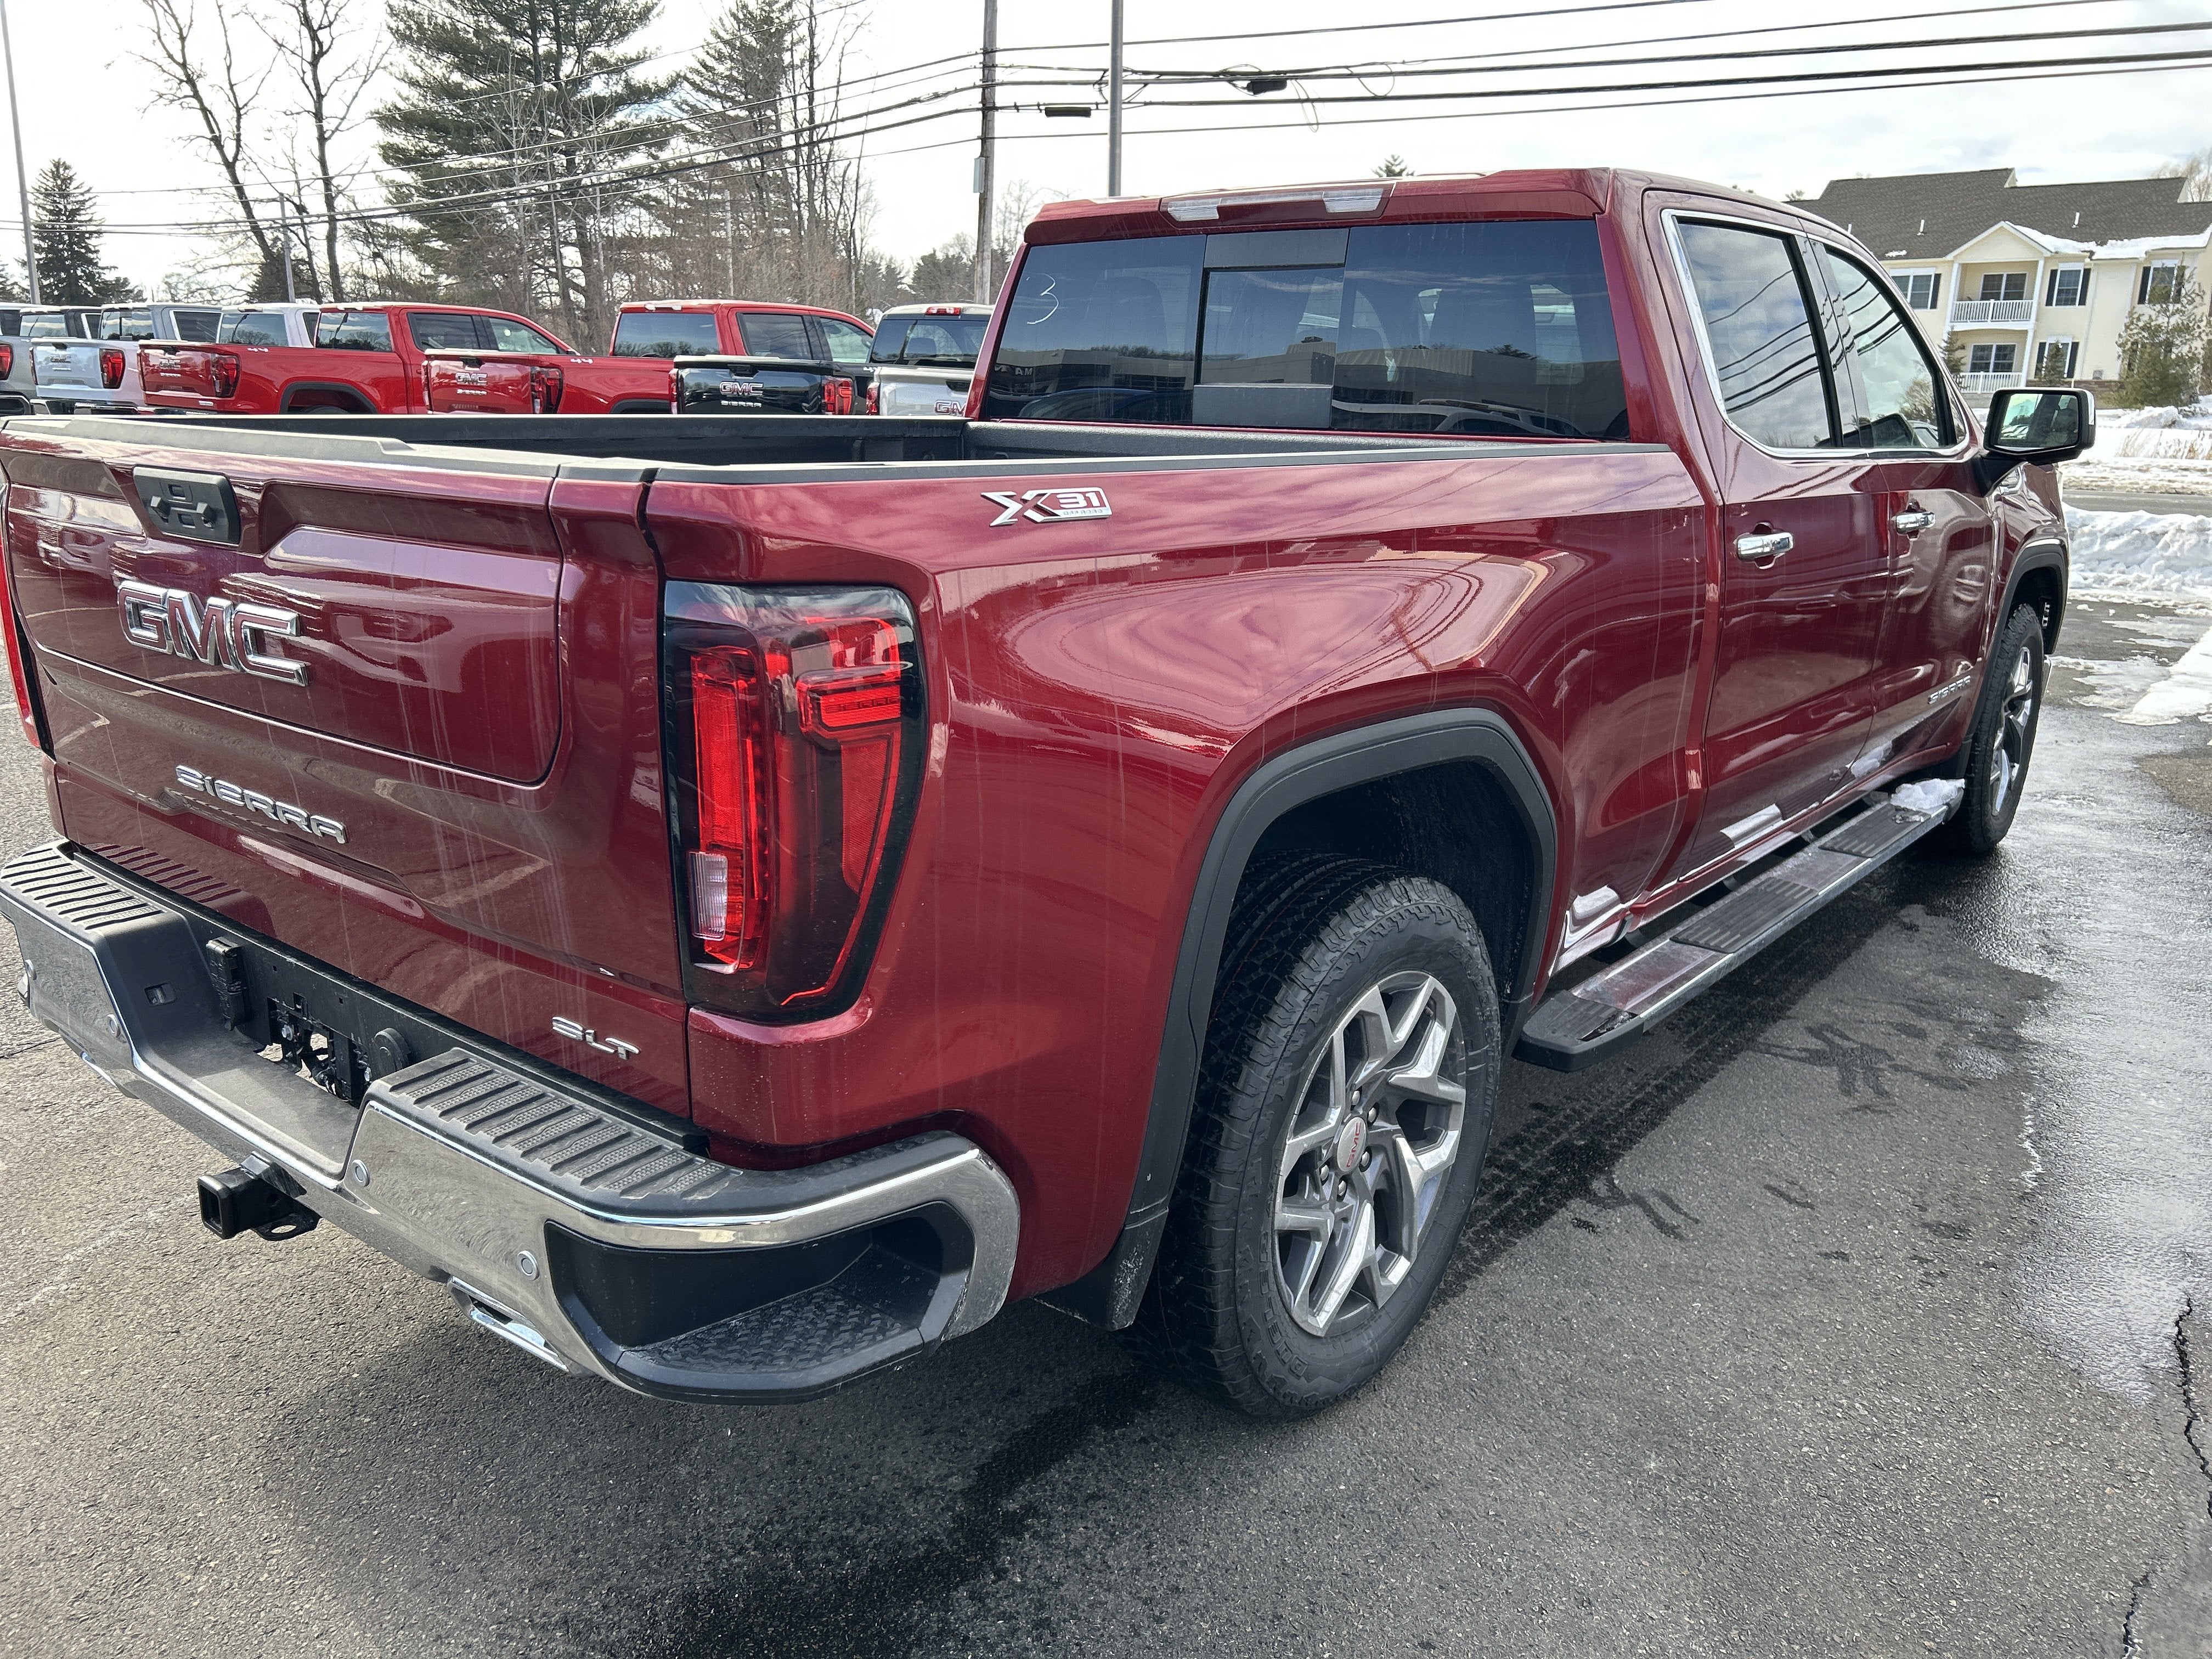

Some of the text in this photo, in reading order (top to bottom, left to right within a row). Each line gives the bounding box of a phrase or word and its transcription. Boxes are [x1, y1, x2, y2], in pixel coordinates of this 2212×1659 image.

[1027, 273, 1059, 324] 3
[455, 372, 488, 386] GMC
[719, 381, 764, 397] GMC
[720, 400, 763, 408] SIERRA
[935, 400, 966, 416] GM
[117, 579, 309, 687] GMC
[174, 764, 349, 845] SIERRA
[552, 1016, 641, 1060] SLT
[1346, 1121, 1361, 1167] GMC
